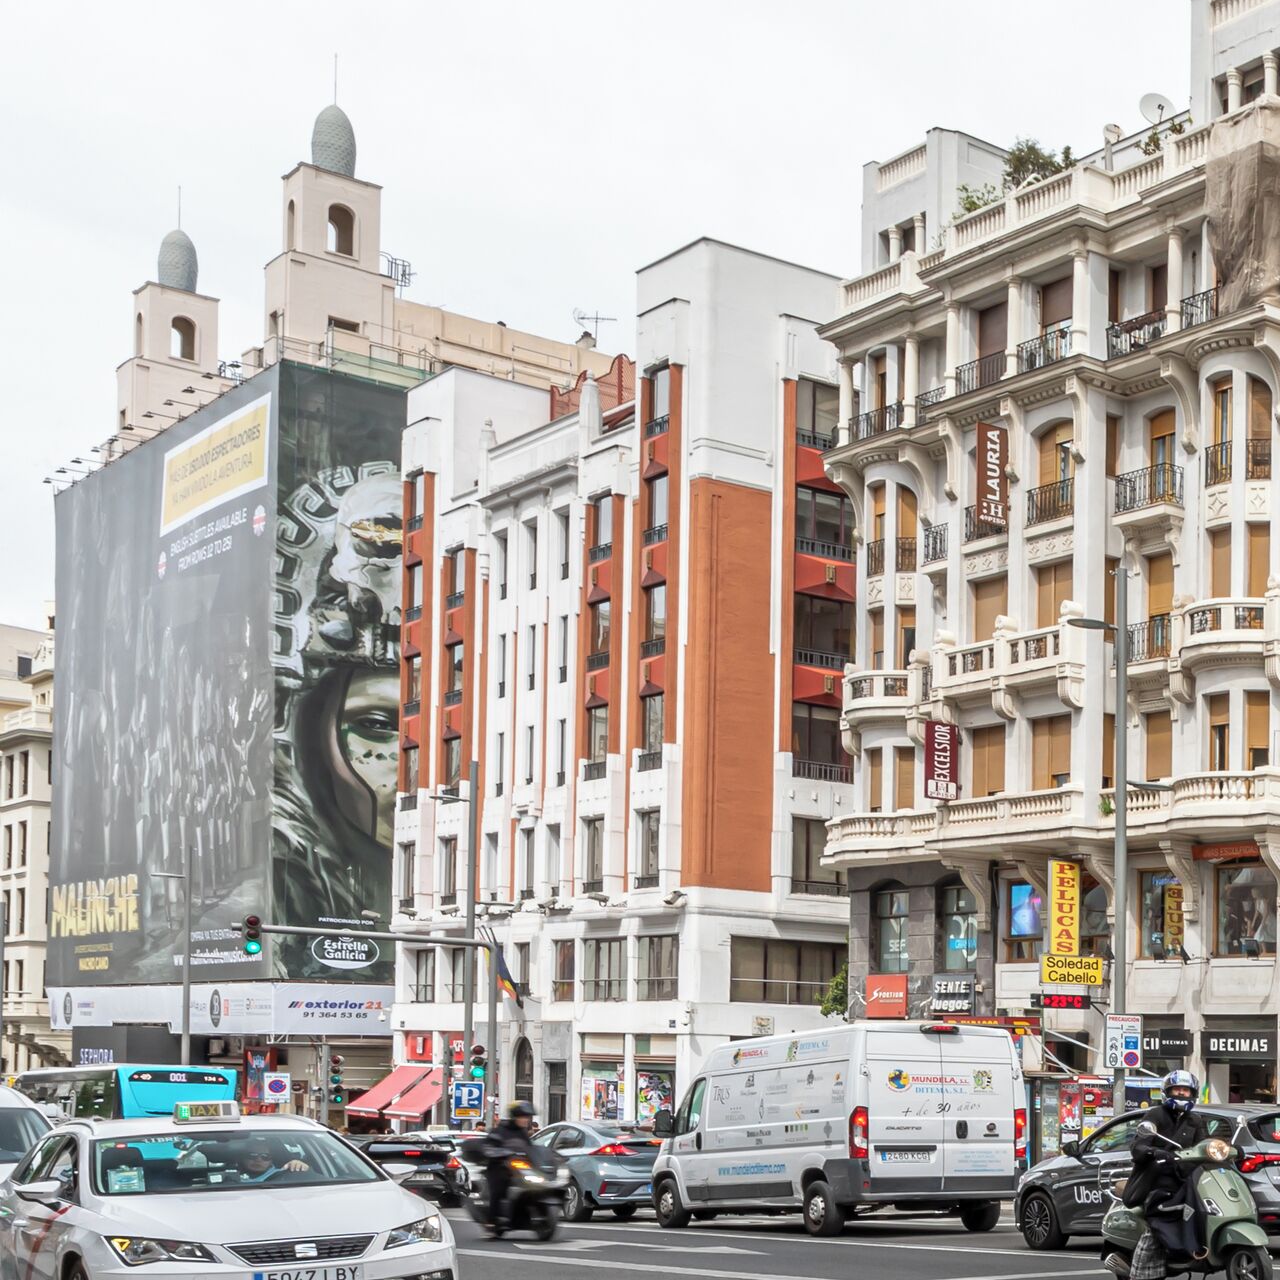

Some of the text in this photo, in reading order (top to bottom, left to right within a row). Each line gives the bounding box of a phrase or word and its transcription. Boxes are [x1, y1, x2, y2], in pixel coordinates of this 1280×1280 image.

[987, 430, 1000, 501] LAURIA
[170, 507, 248, 557] ENGLISH SUBTITLES AVAILABLE
[178, 551, 192, 572] FROM
[191, 543, 207, 566] ROWS
[934, 724, 951, 782] EXCELSIOR
[51, 873, 139, 937] MALINCHE
[1055, 863, 1076, 953] PELUCAS
[318, 917, 360, 925] PATROCINADO
[323, 939, 368, 951] Estrella
[324, 949, 366, 961] Galicia
[1046, 956, 1099, 970] Soledad
[1048, 970, 1097, 984] Cabello
[930, 999, 969, 1011] Juegos
[1210, 1038, 1268, 1052] DECIMAS
[80, 1049, 114, 1064] SEPHORA
[460, 1087, 480, 1108] P
[936, 1102, 951, 1114] 30
[888, 1152, 928, 1161] 2480 KCG
[1074, 1186, 1102, 1204] Uber
